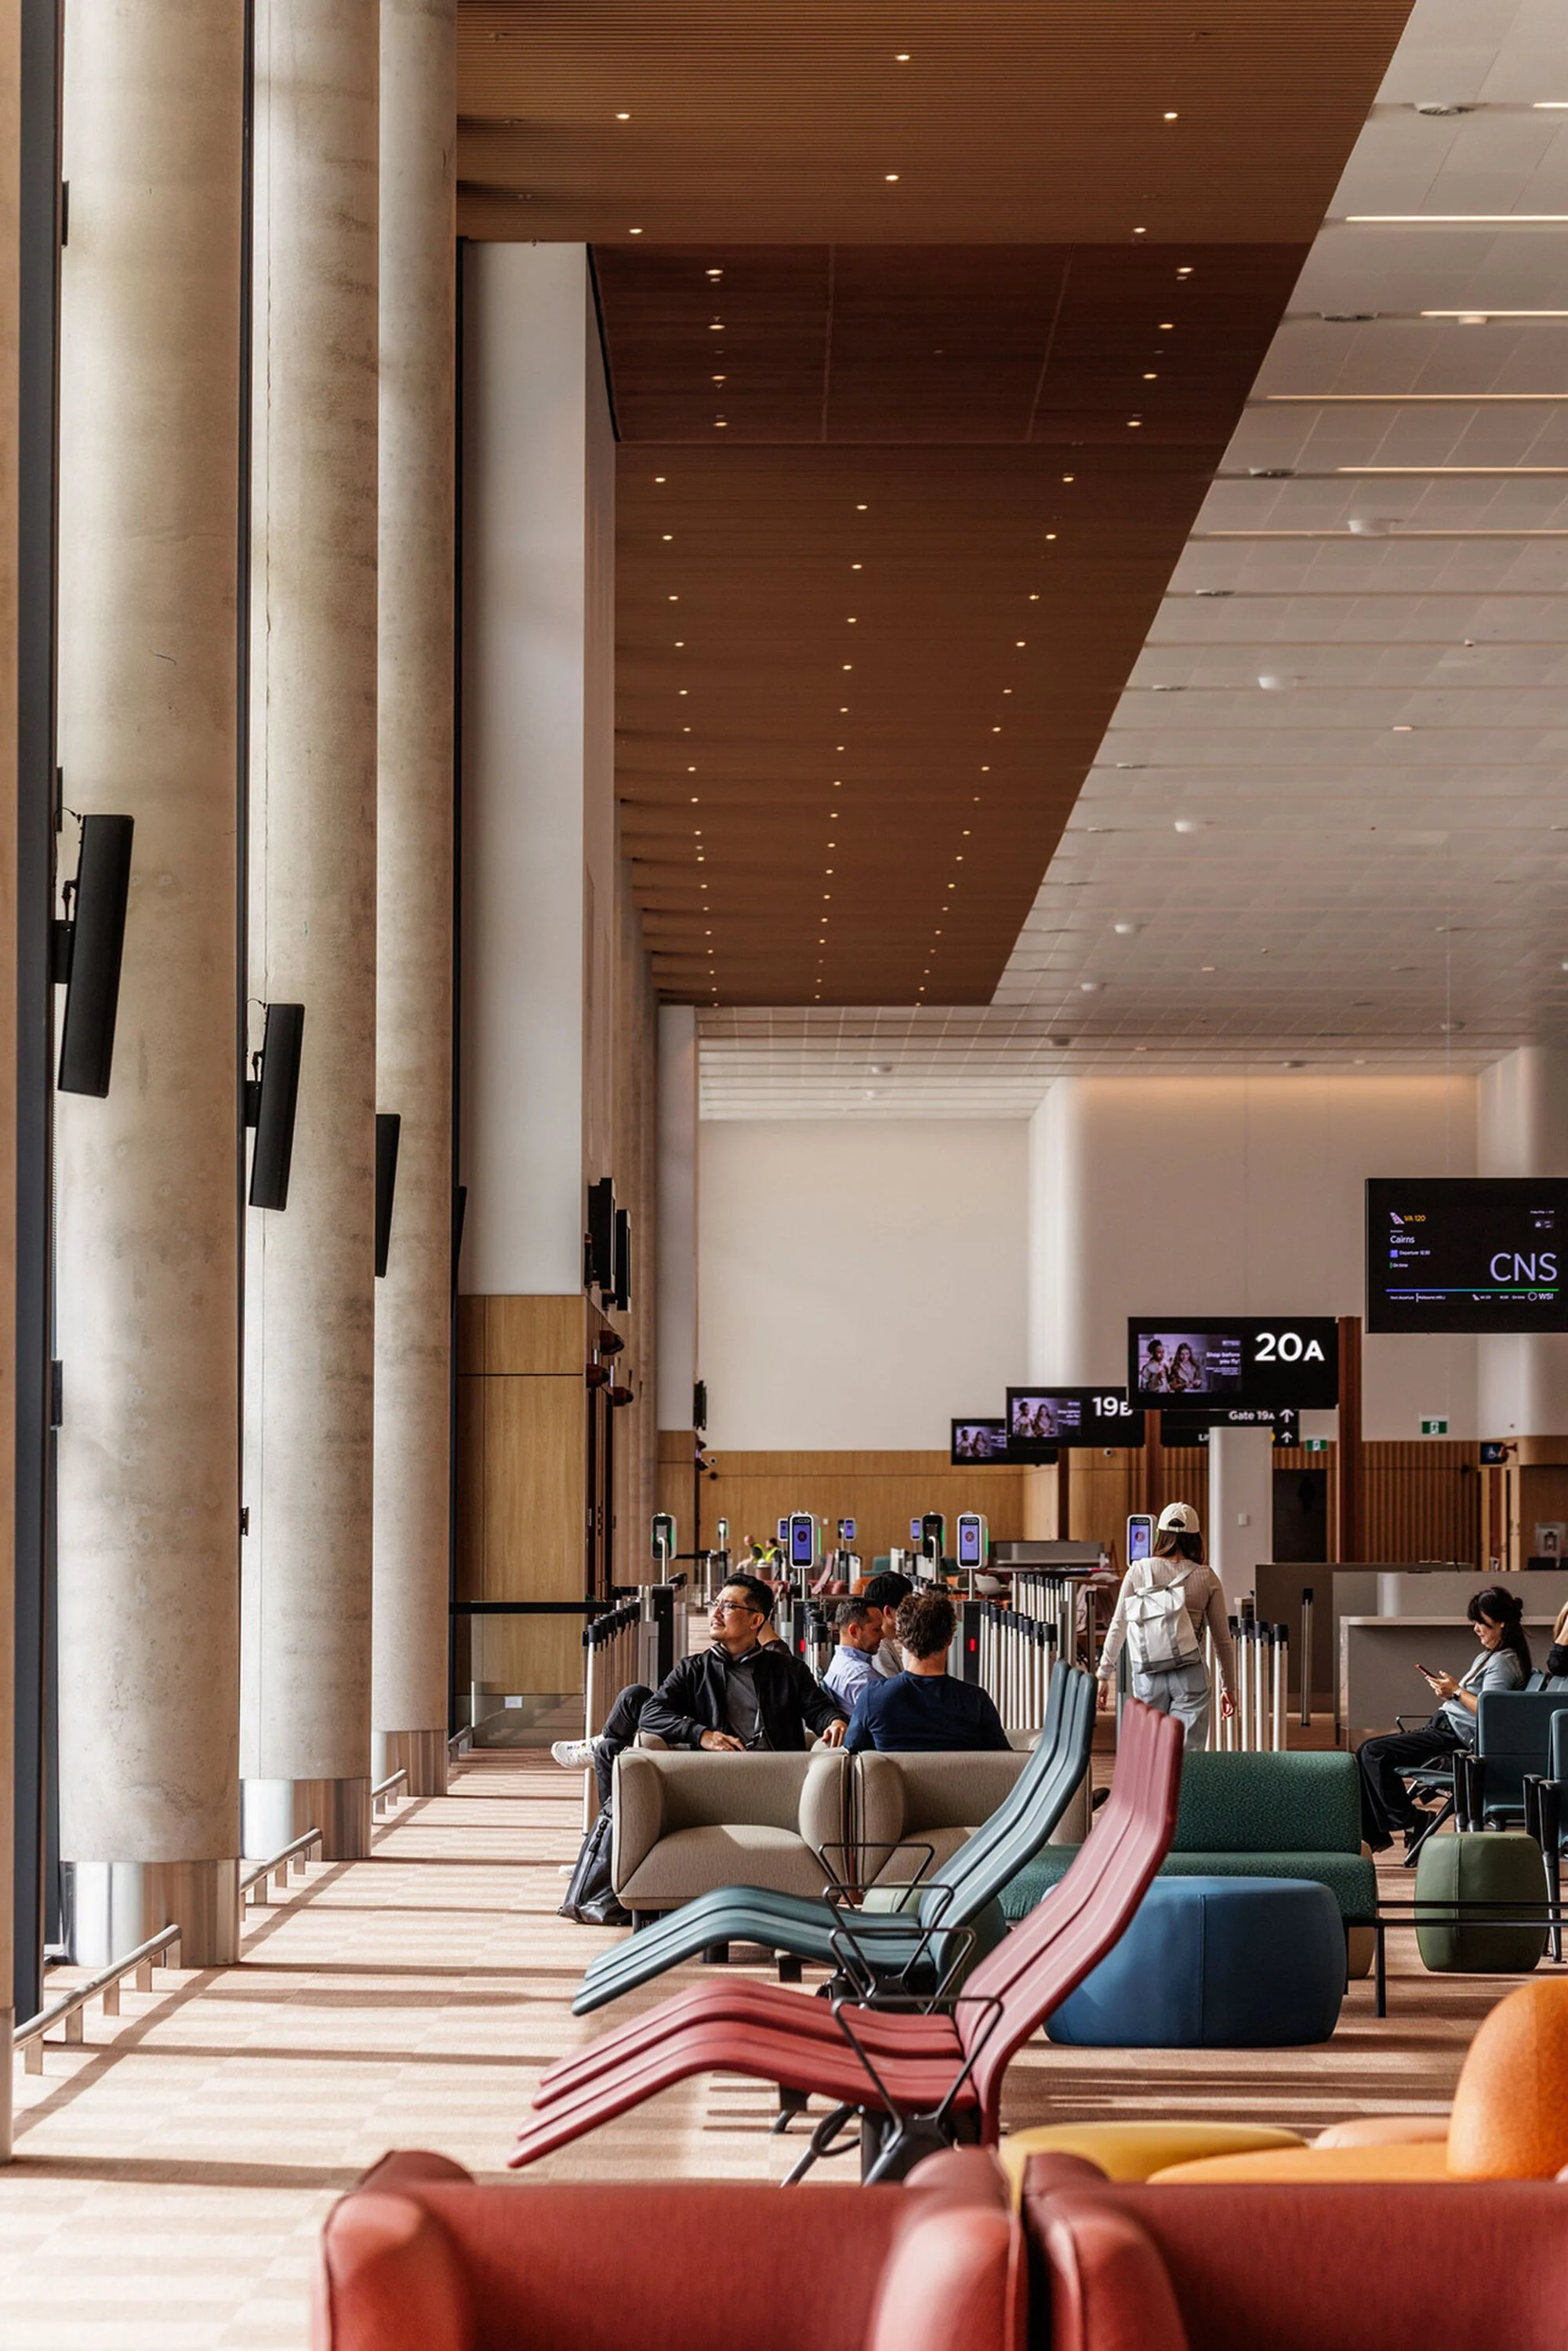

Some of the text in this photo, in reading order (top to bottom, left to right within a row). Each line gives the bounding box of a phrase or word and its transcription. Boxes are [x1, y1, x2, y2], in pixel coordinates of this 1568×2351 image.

[1390, 1235, 1415, 1244] Cairns
[1490, 1252, 1558, 1282] CNS
[1254, 1332, 1326, 1362] 20A
[1229, 1411, 1276, 1420] Gate 19A
